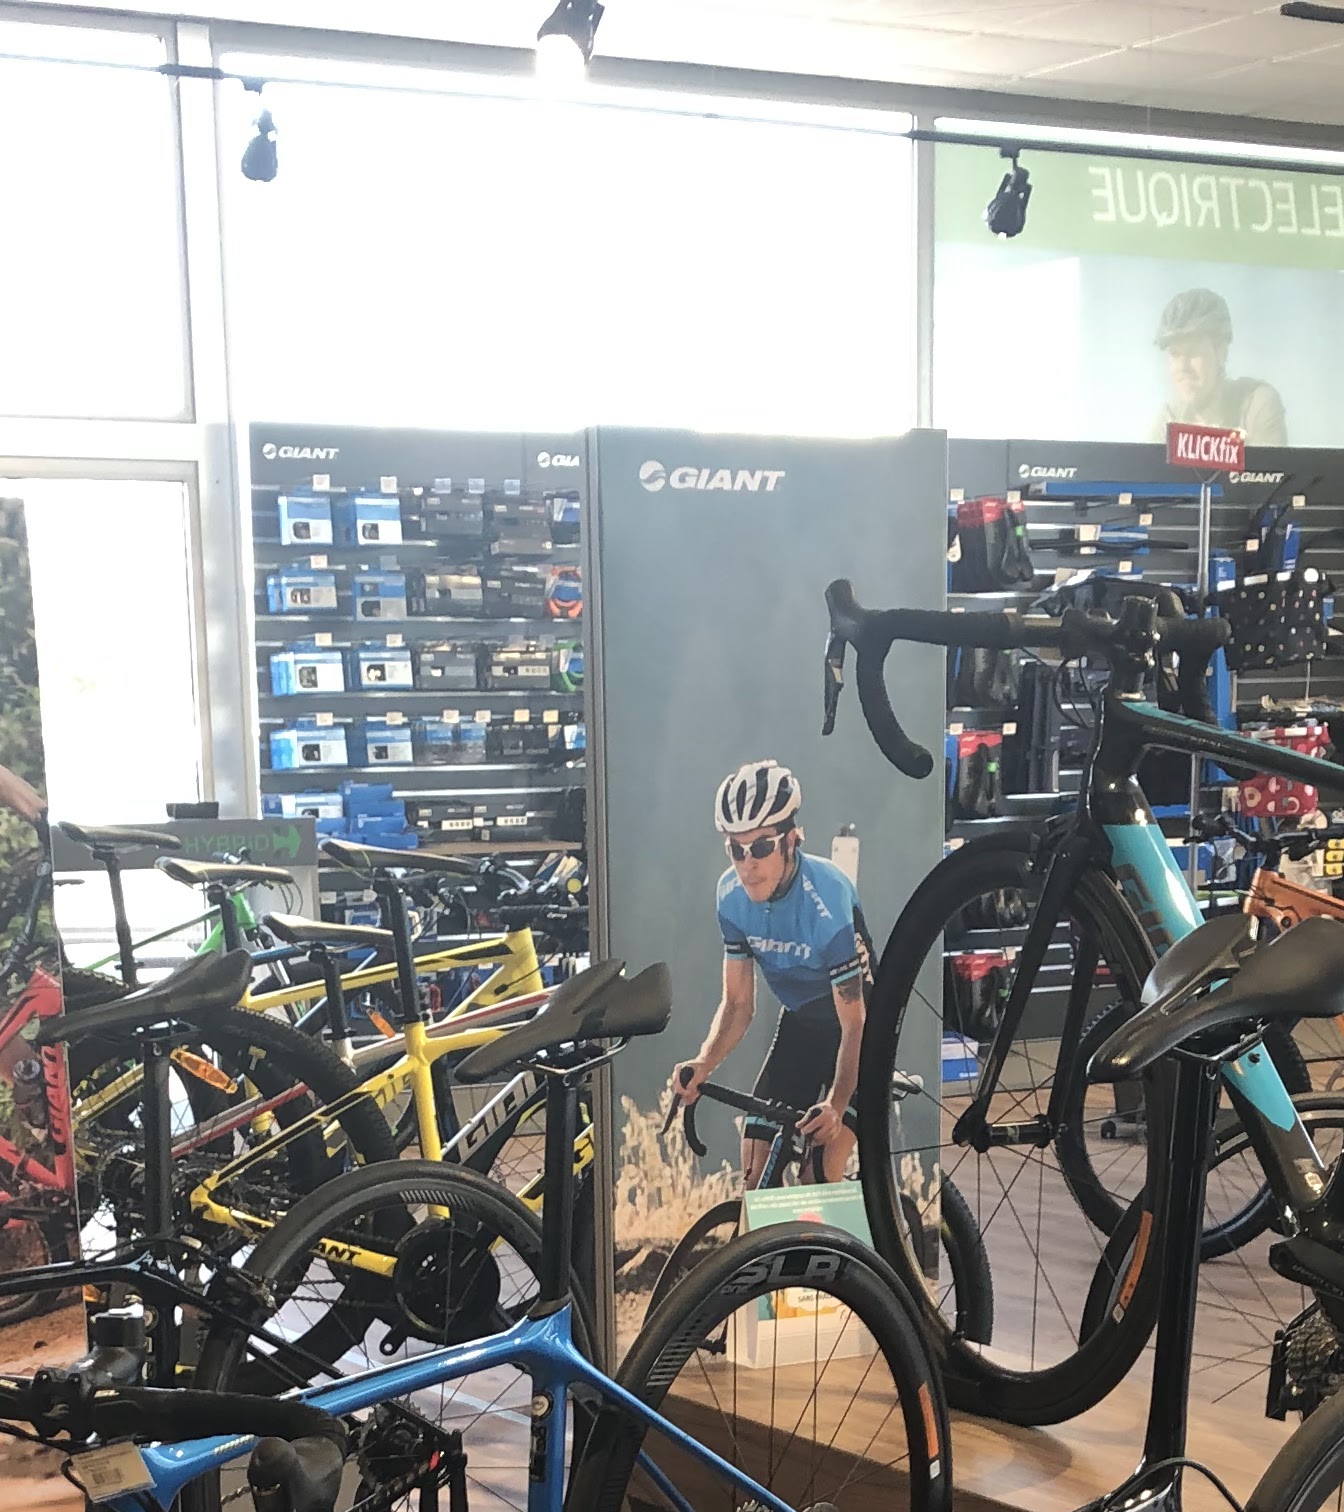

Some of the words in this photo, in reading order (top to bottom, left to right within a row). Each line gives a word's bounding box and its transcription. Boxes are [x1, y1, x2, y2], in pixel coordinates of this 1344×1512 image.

[278, 446, 339, 460] GIANT
[551, 454, 581, 467] GIA
[669, 467, 785, 492] GIANT
[1030, 467, 1077, 479] GIANT
[1240, 472, 1285, 484] GIANT
